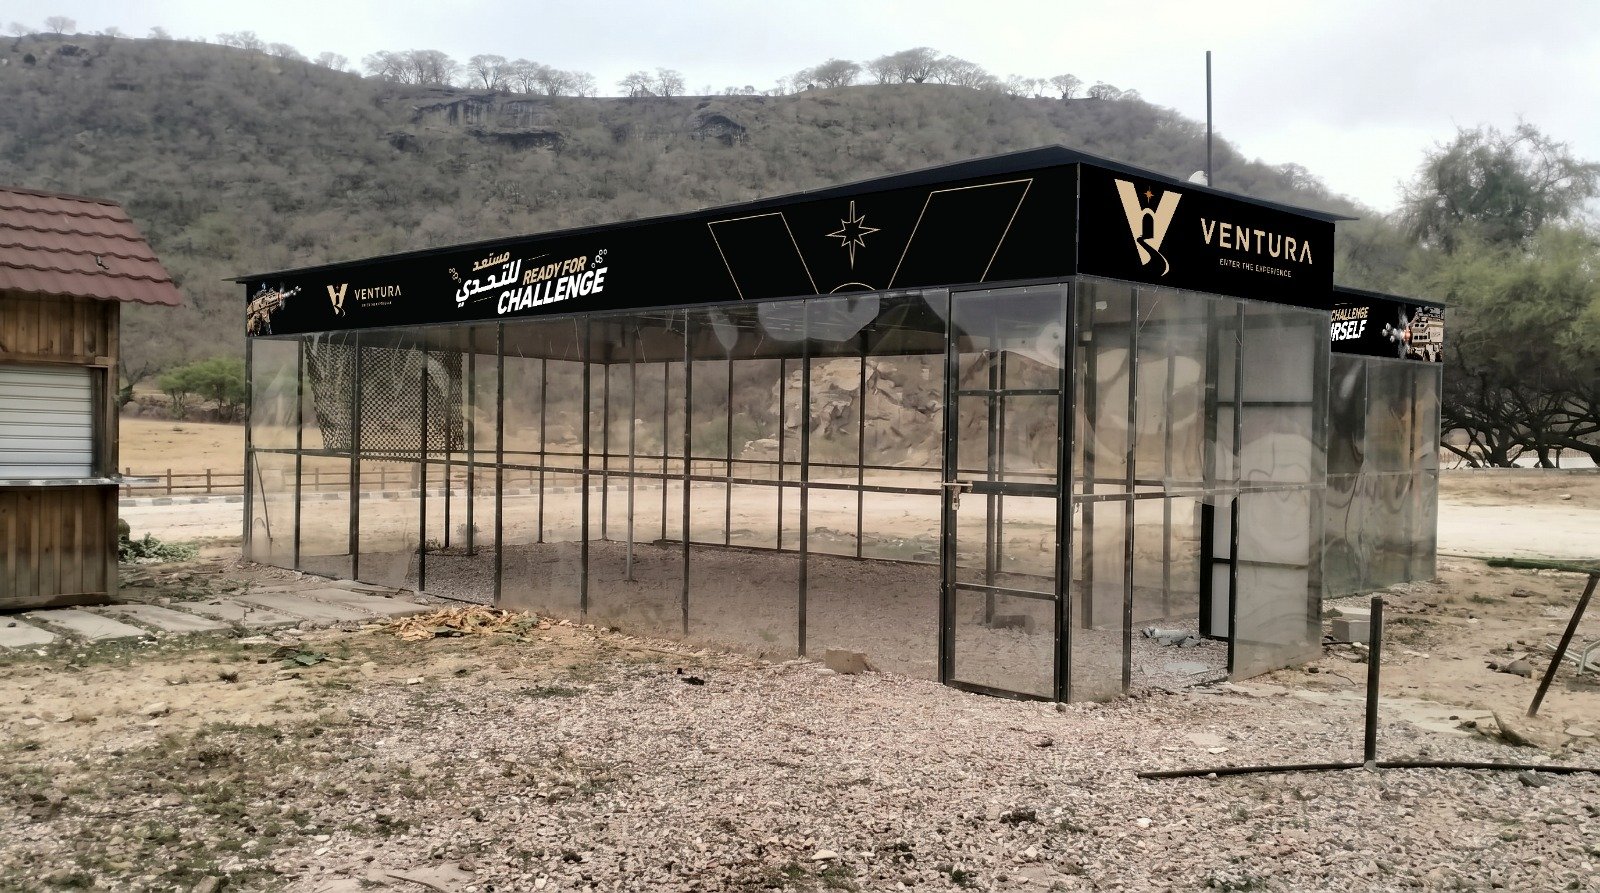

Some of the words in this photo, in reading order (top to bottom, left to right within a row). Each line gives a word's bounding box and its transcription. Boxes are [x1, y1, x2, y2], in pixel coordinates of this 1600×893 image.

[1200, 217, 1313, 265] VENTURA
[472, 251, 510, 271] مستعد
[522, 262, 562, 285] READY
[562, 255, 587, 276] FOR
[1219, 258, 1241, 269] ENTER
[1242, 262, 1254, 271] THE
[1255, 264, 1292, 278] EXPERIENCE
[354, 284, 402, 301] VENTURA
[455, 259, 522, 308] للتحدي
[497, 267, 608, 315] CHALLENGE
[1331, 306, 1369, 321] CHALLENGE
